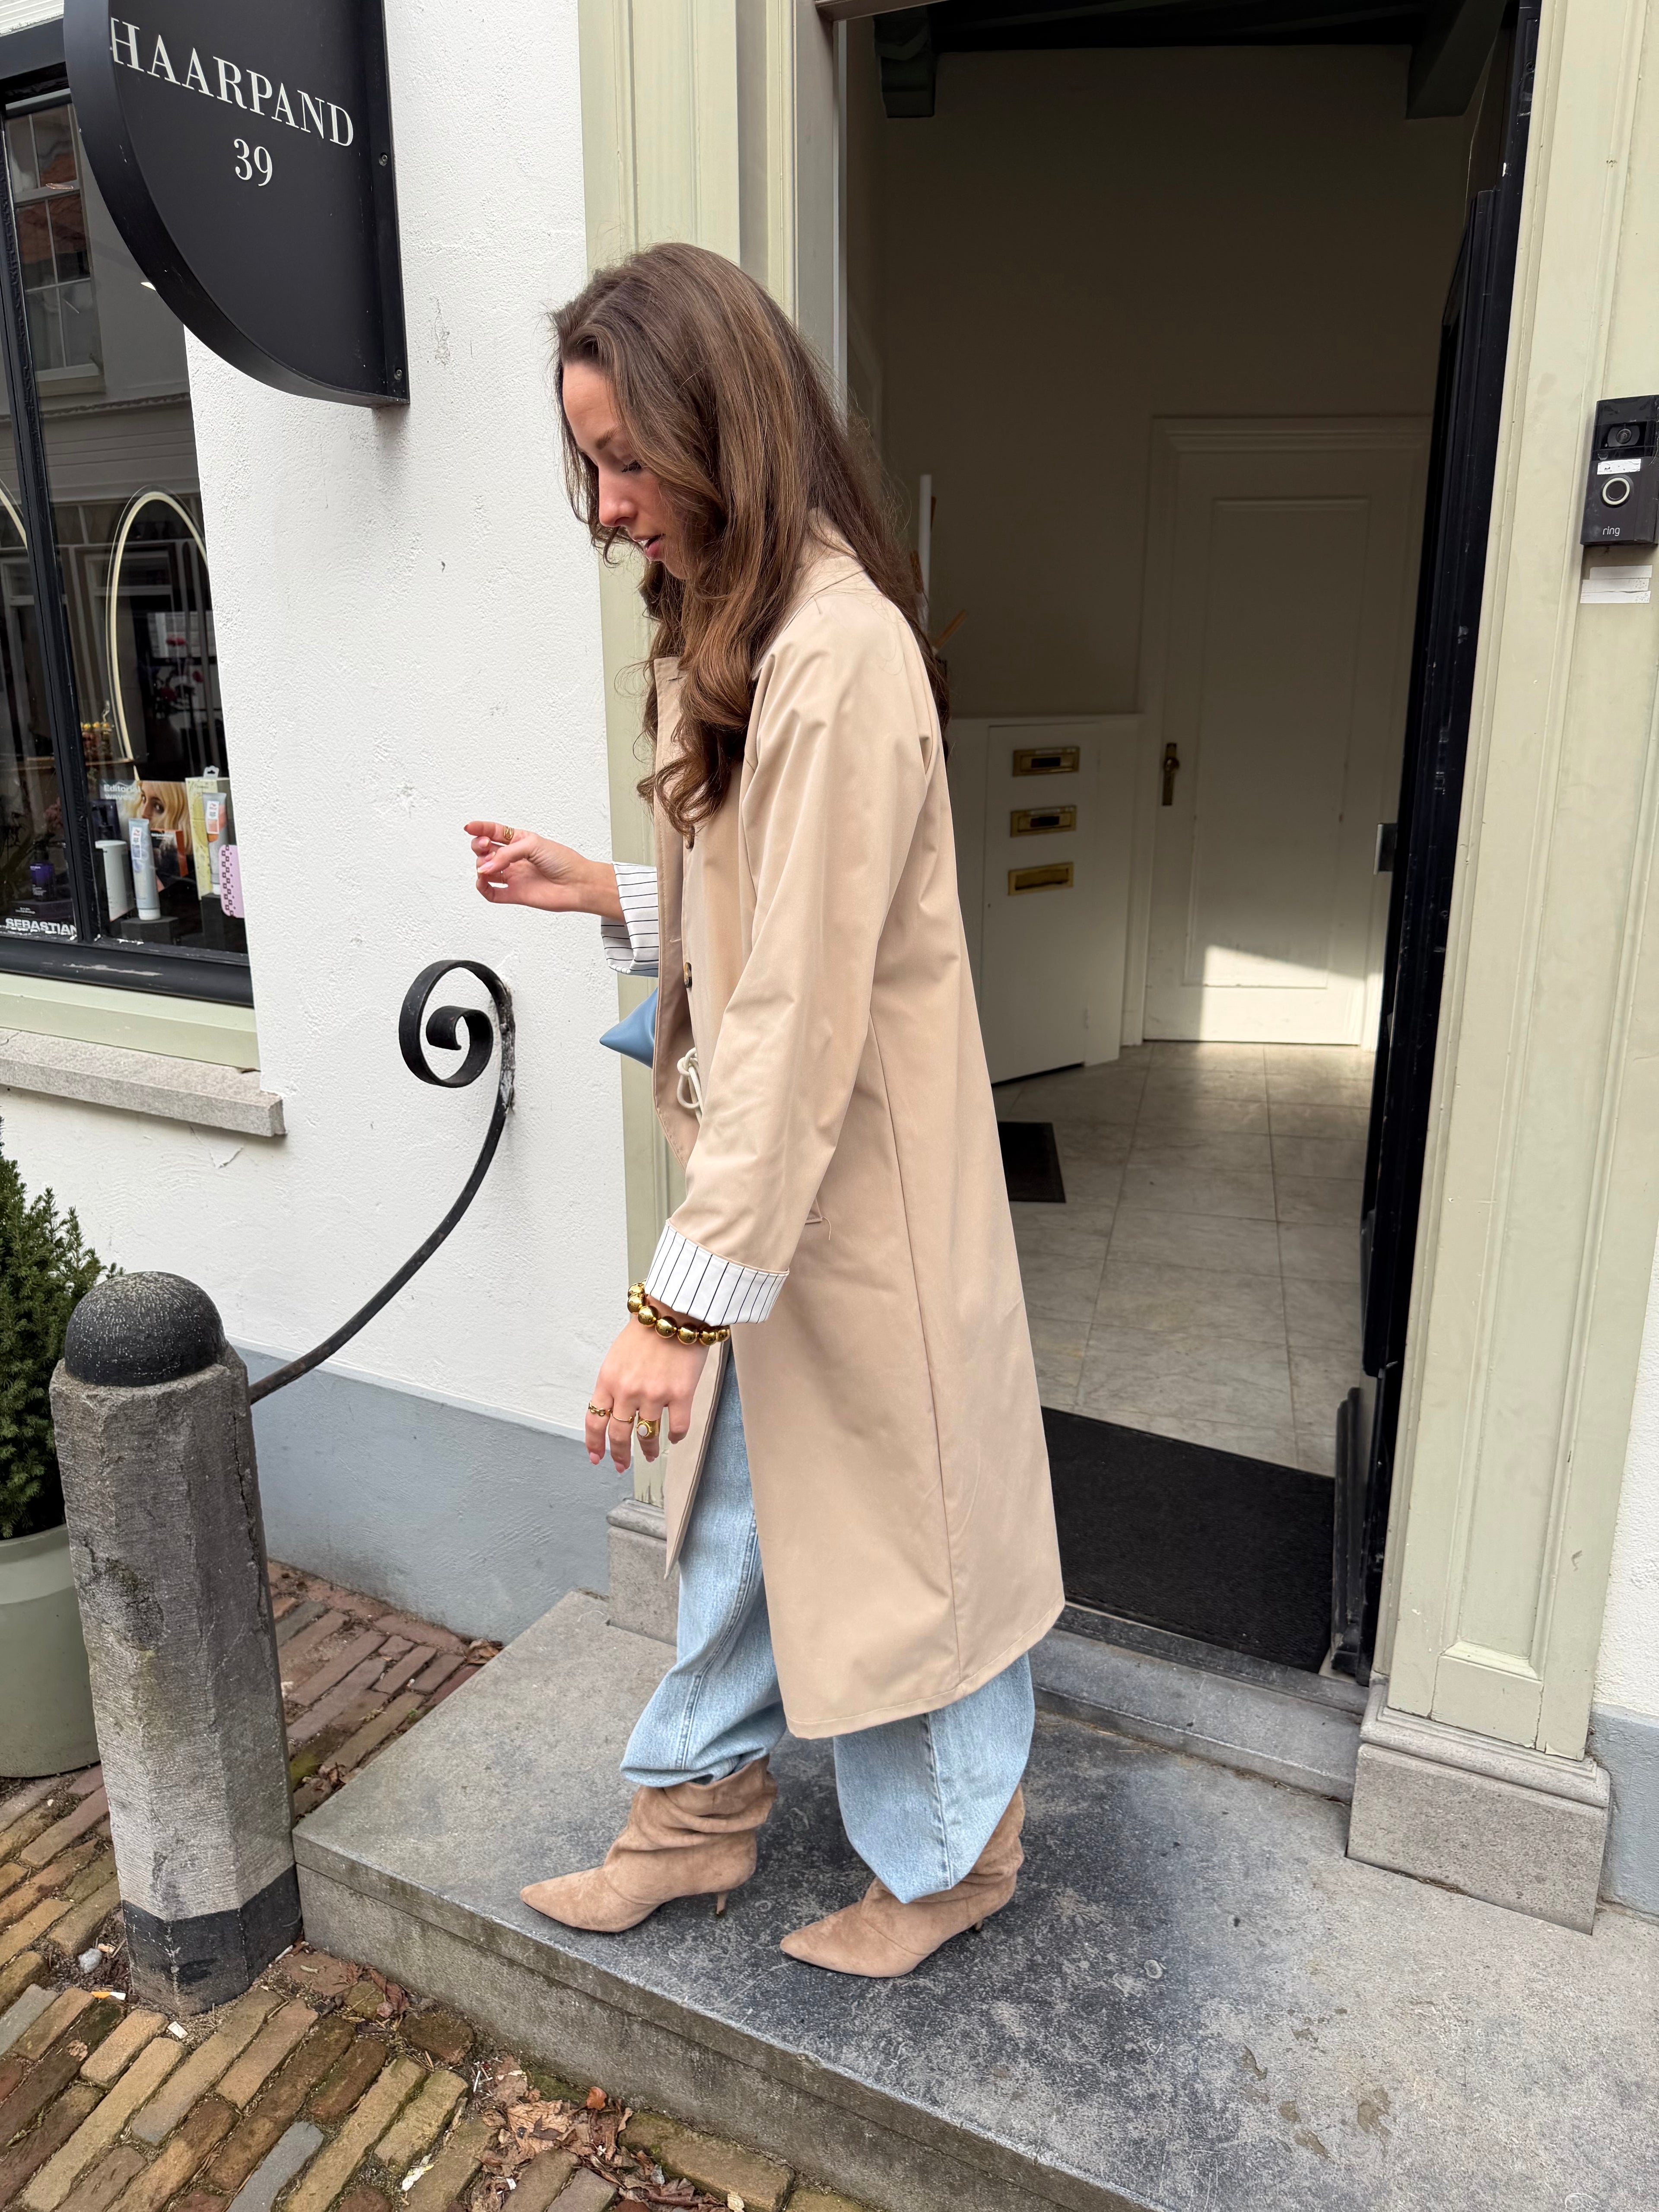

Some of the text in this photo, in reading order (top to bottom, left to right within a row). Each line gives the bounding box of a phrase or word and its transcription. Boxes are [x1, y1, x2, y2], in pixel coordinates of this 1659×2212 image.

[111, 17, 353, 146] HAARPAND
[234, 139, 273, 186] 39
[1602, 526, 1620, 537] ring
[5, 918, 77, 936] SEBASTIAN
